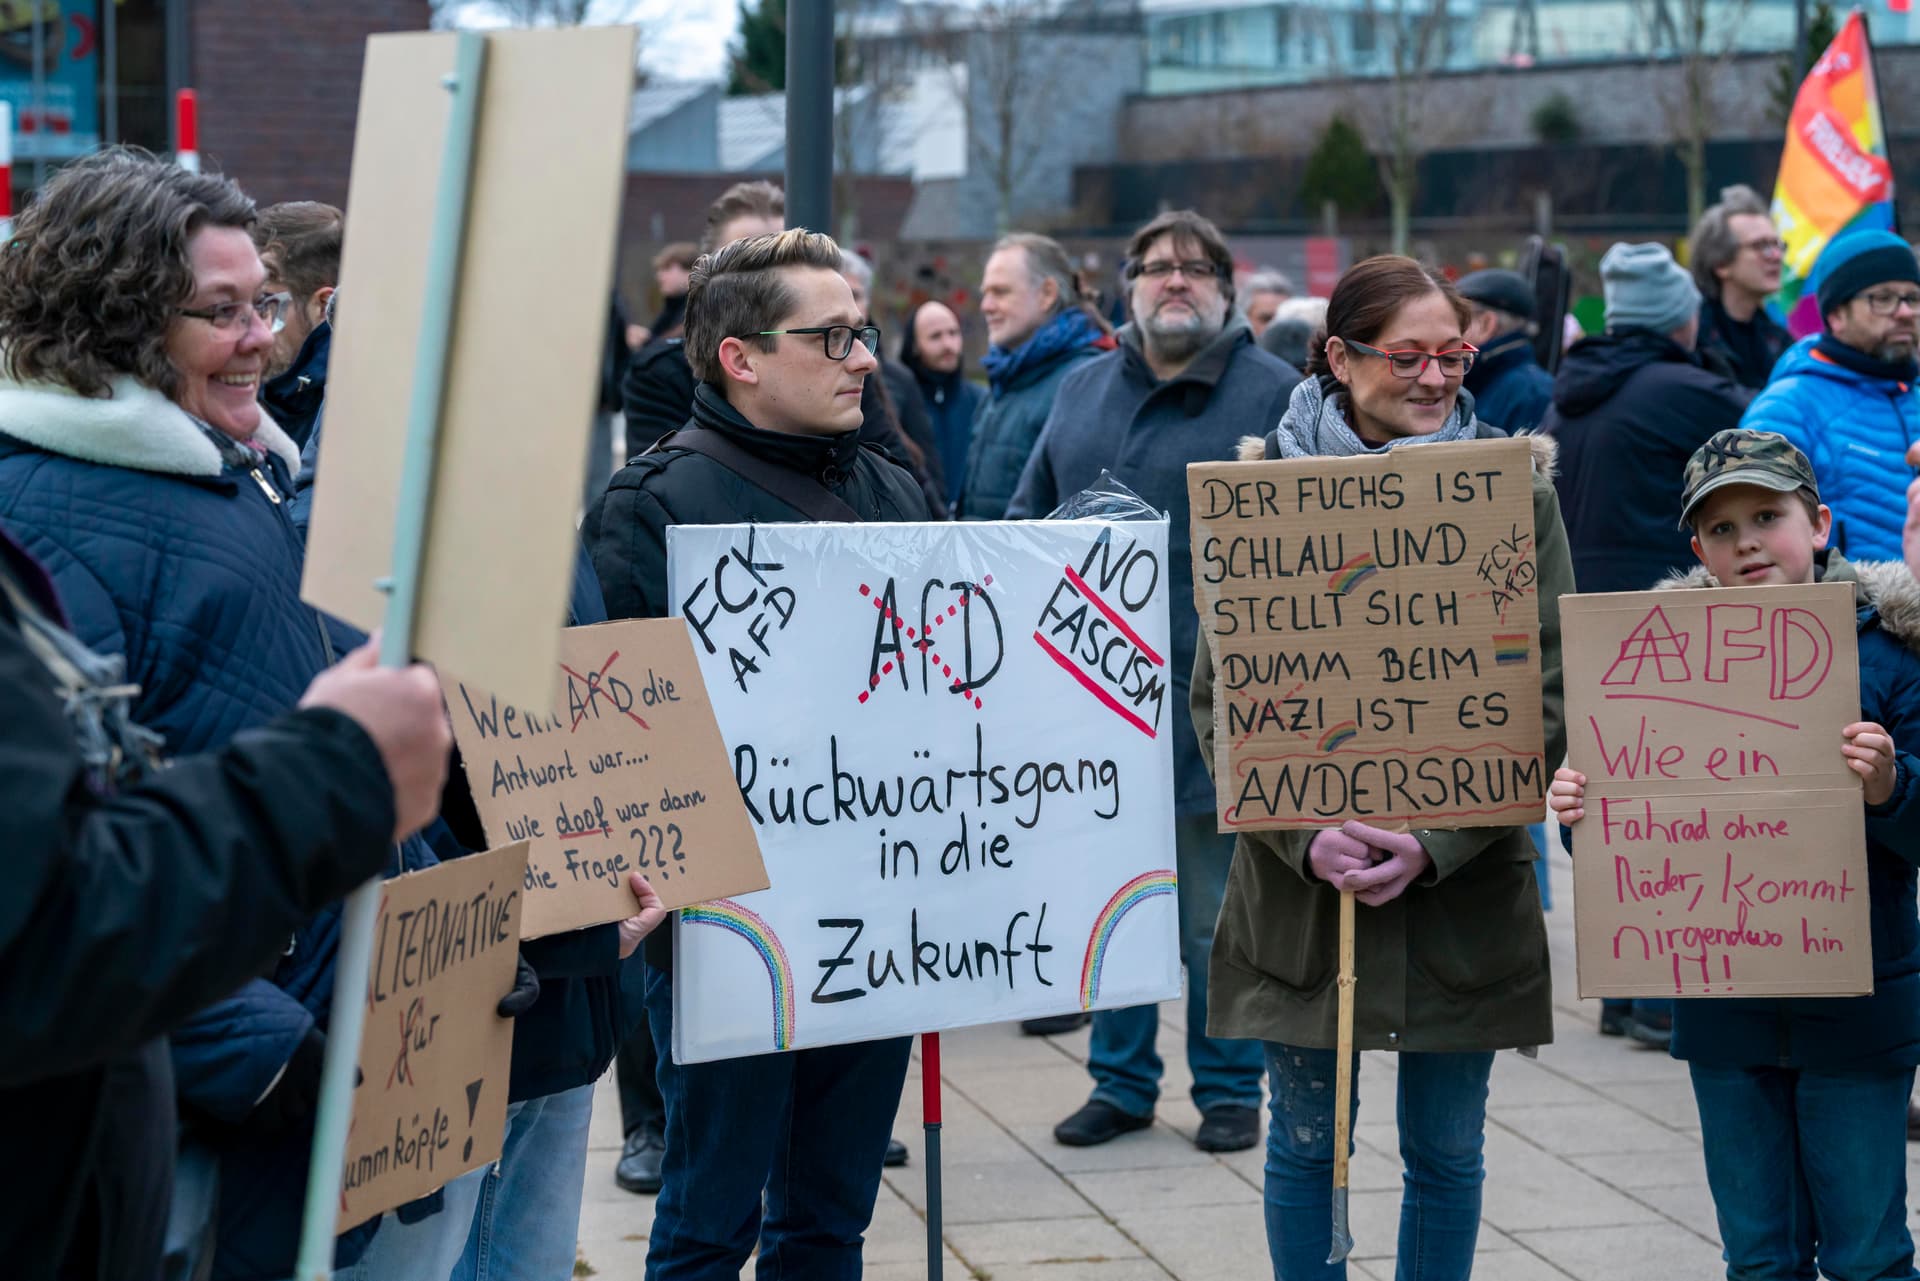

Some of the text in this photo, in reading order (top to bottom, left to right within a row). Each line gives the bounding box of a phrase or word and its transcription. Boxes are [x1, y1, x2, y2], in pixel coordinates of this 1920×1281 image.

[1201, 470, 1501, 519] DER FUCHS IST
[1079, 526, 1158, 612] NO
[1203, 523, 1466, 583] SCHLAU UND
[1477, 523, 1529, 586] FCK
[683, 526, 784, 654] FCK
[1214, 590, 1458, 635] STELLT SICH
[1491, 561, 1536, 616] AFD
[729, 586, 796, 693] AFD
[1039, 578, 1167, 731] FASCISM
[1222, 647, 1479, 690] DUMM BEIM
[1601, 604, 1833, 700] AFD
[642, 668, 680, 706] die
[1229, 692, 1508, 736] NAZI IST ES
[492, 749, 577, 797] Antwort
[735, 723, 1119, 828] Rückwärtsgang
[1589, 716, 1778, 781] Wie ein
[556, 796, 609, 838] doof
[616, 802, 649, 823] war
[660, 788, 705, 812] dann
[1235, 757, 1544, 817] ANDERSRUM
[880, 812, 1013, 879] in die
[1600, 798, 1789, 845] Fahrad ohne
[523, 862, 557, 890] die
[375, 881, 518, 1002] LTERNATIVE
[811, 902, 1053, 1003] Zukunft
[1613, 901, 1843, 960] nirgendwo hin
[344, 1107, 449, 1191] ummköpfe
